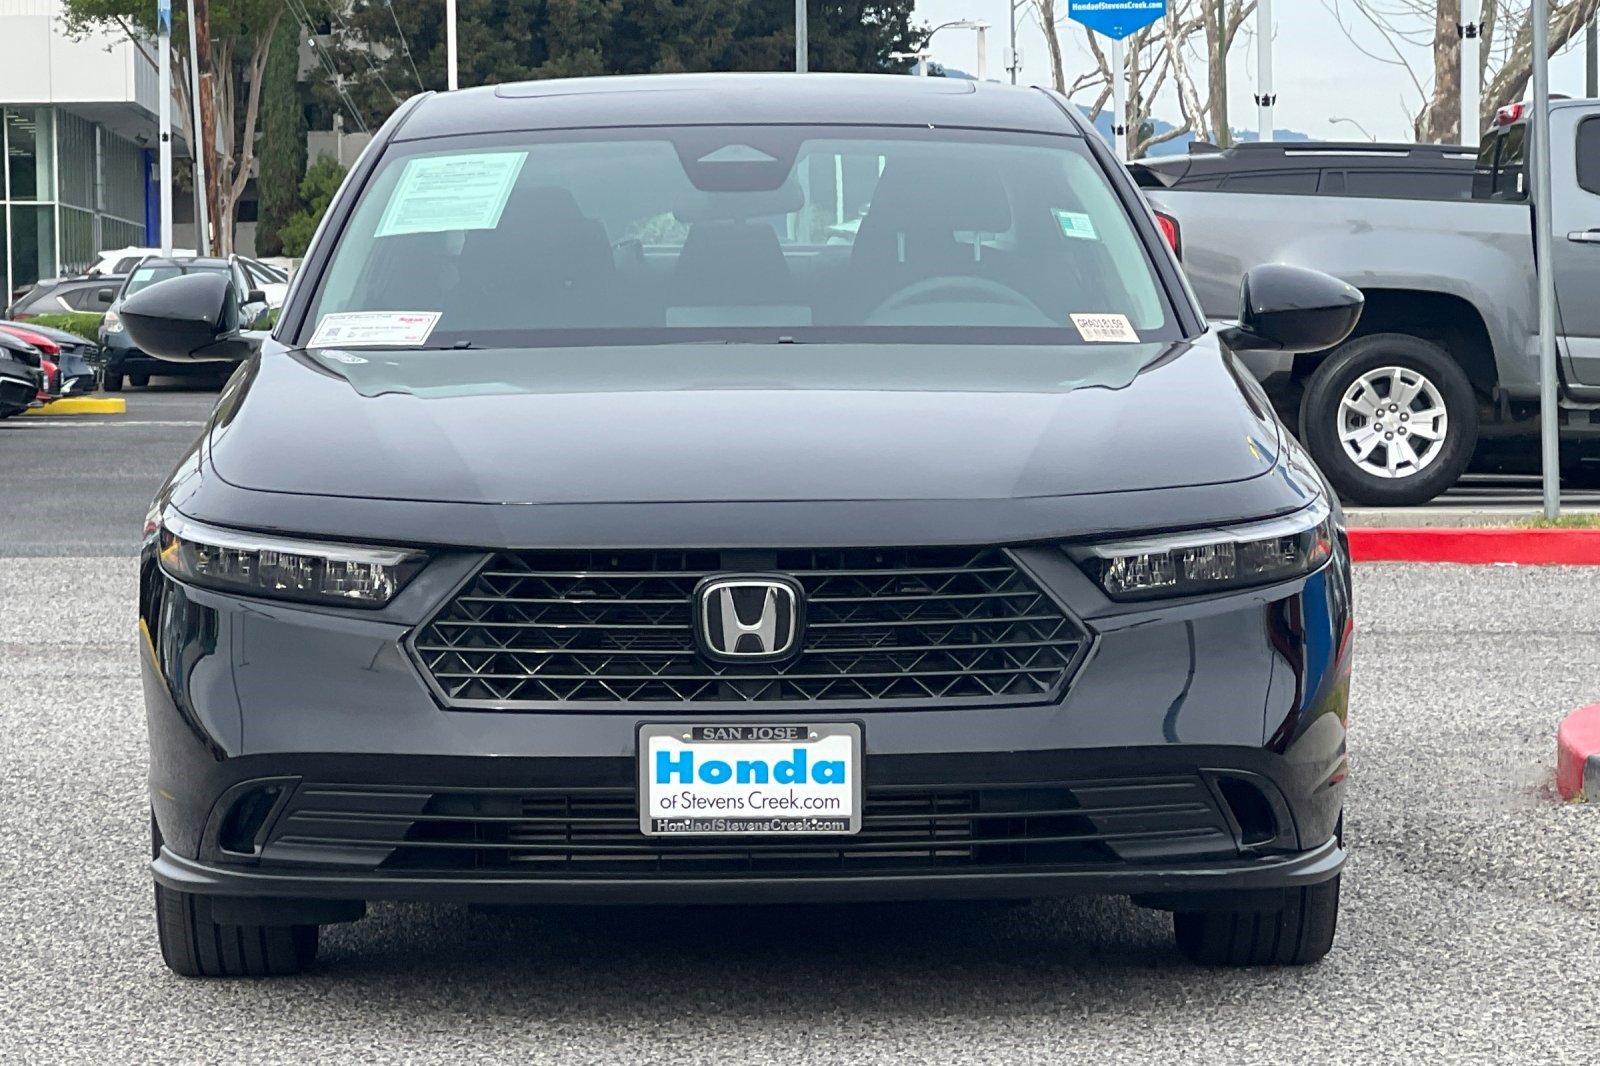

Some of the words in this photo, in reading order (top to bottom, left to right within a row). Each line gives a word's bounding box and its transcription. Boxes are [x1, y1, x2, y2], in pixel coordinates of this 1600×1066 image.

[1072, 1, 1163, 11] HondaofStevensCreek.com
[703, 727, 742, 741] SAN
[747, 727, 798, 741] JOSE
[656, 748, 846, 785] Honda
[660, 794, 678, 809] of
[681, 791, 744, 809] Stevens
[748, 788, 840, 810] Creek.com
